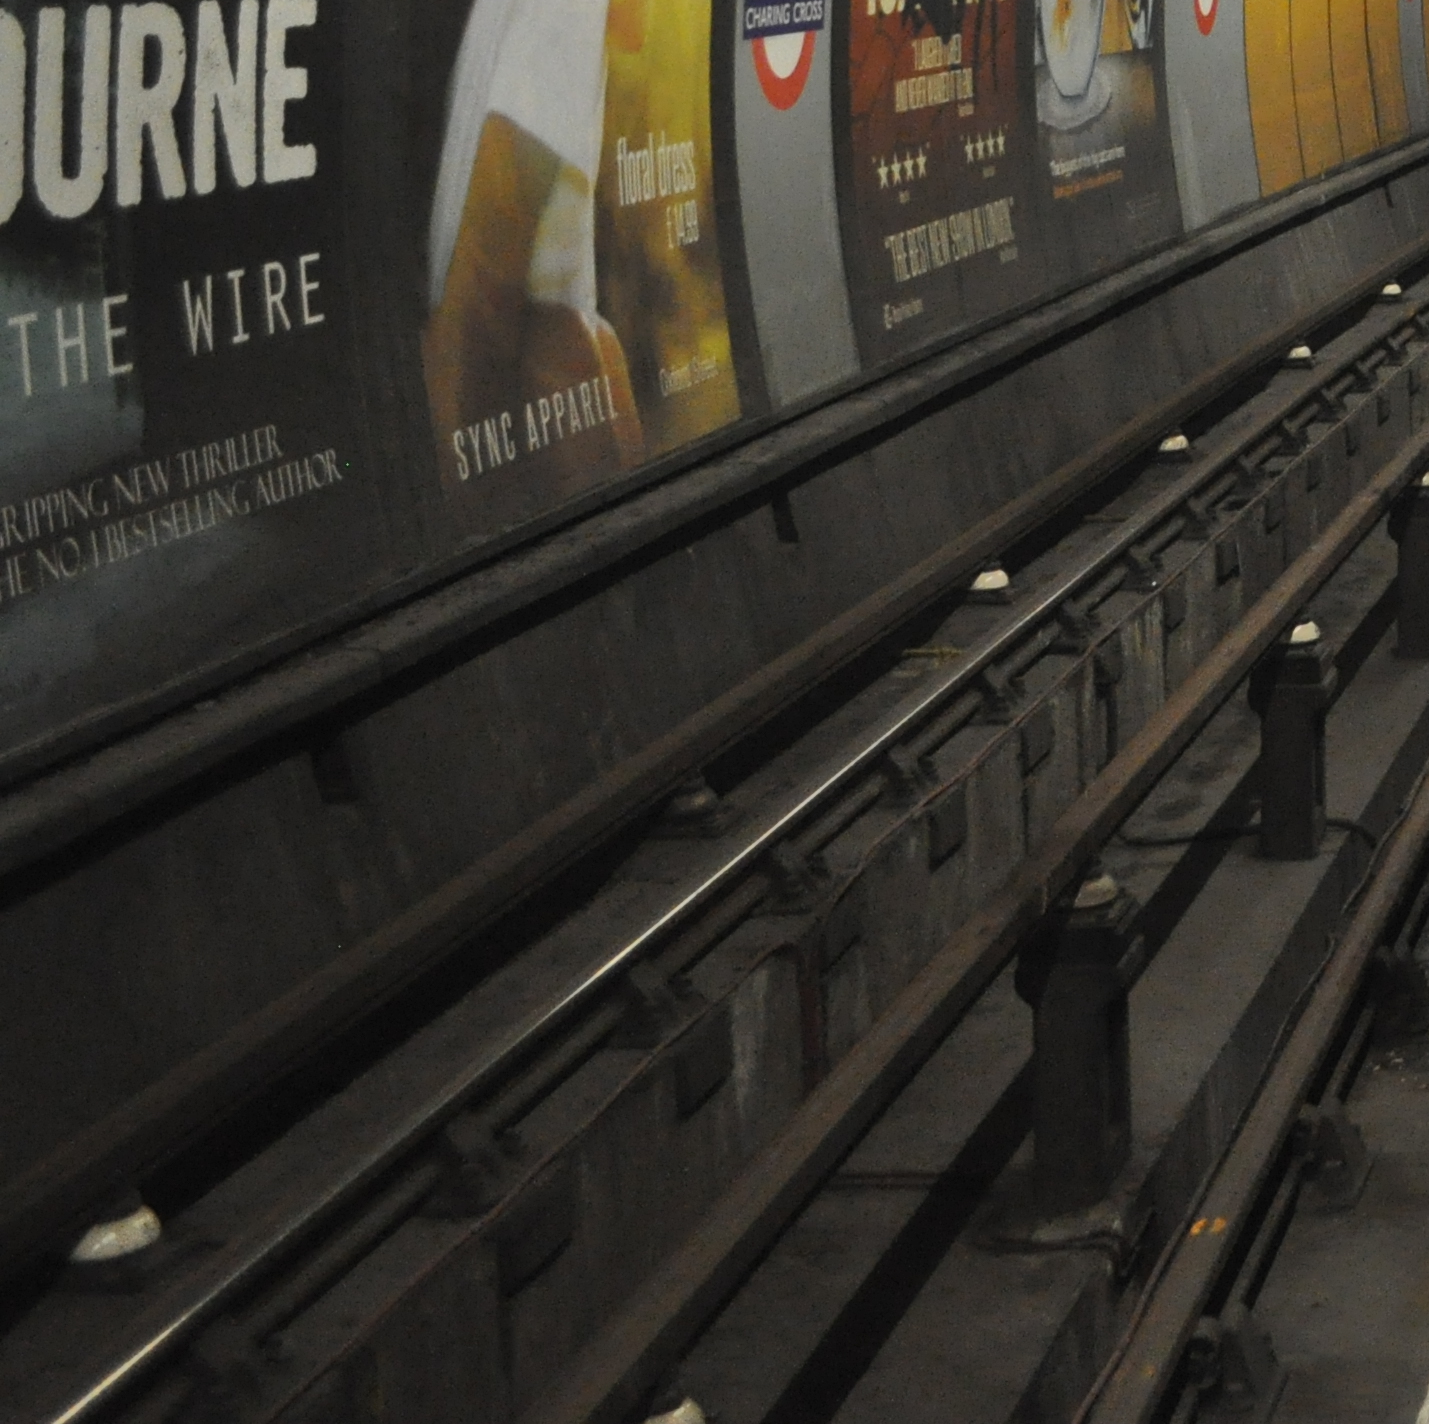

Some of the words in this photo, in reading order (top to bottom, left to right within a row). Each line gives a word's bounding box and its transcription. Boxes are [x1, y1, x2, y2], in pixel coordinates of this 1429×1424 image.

[746, 2, 790, 29] CHARING
[793, 0, 823, 23] CROSS
[617, 132, 656, 206] floral
[658, 131, 697, 198] dress
[8, 294, 133, 397] THE
[182, 252, 325, 357] WIRE
[452, 411, 517, 481] SYNC
[526, 374, 618, 452] APPAREL
[0, 478, 109, 549] RIPPING
[113, 456, 172, 512] NEW
[177, 423, 283, 489] THRILLER
[105, 478, 250, 563] BESTSELLING
[255, 447, 342, 508] AUTHOR
